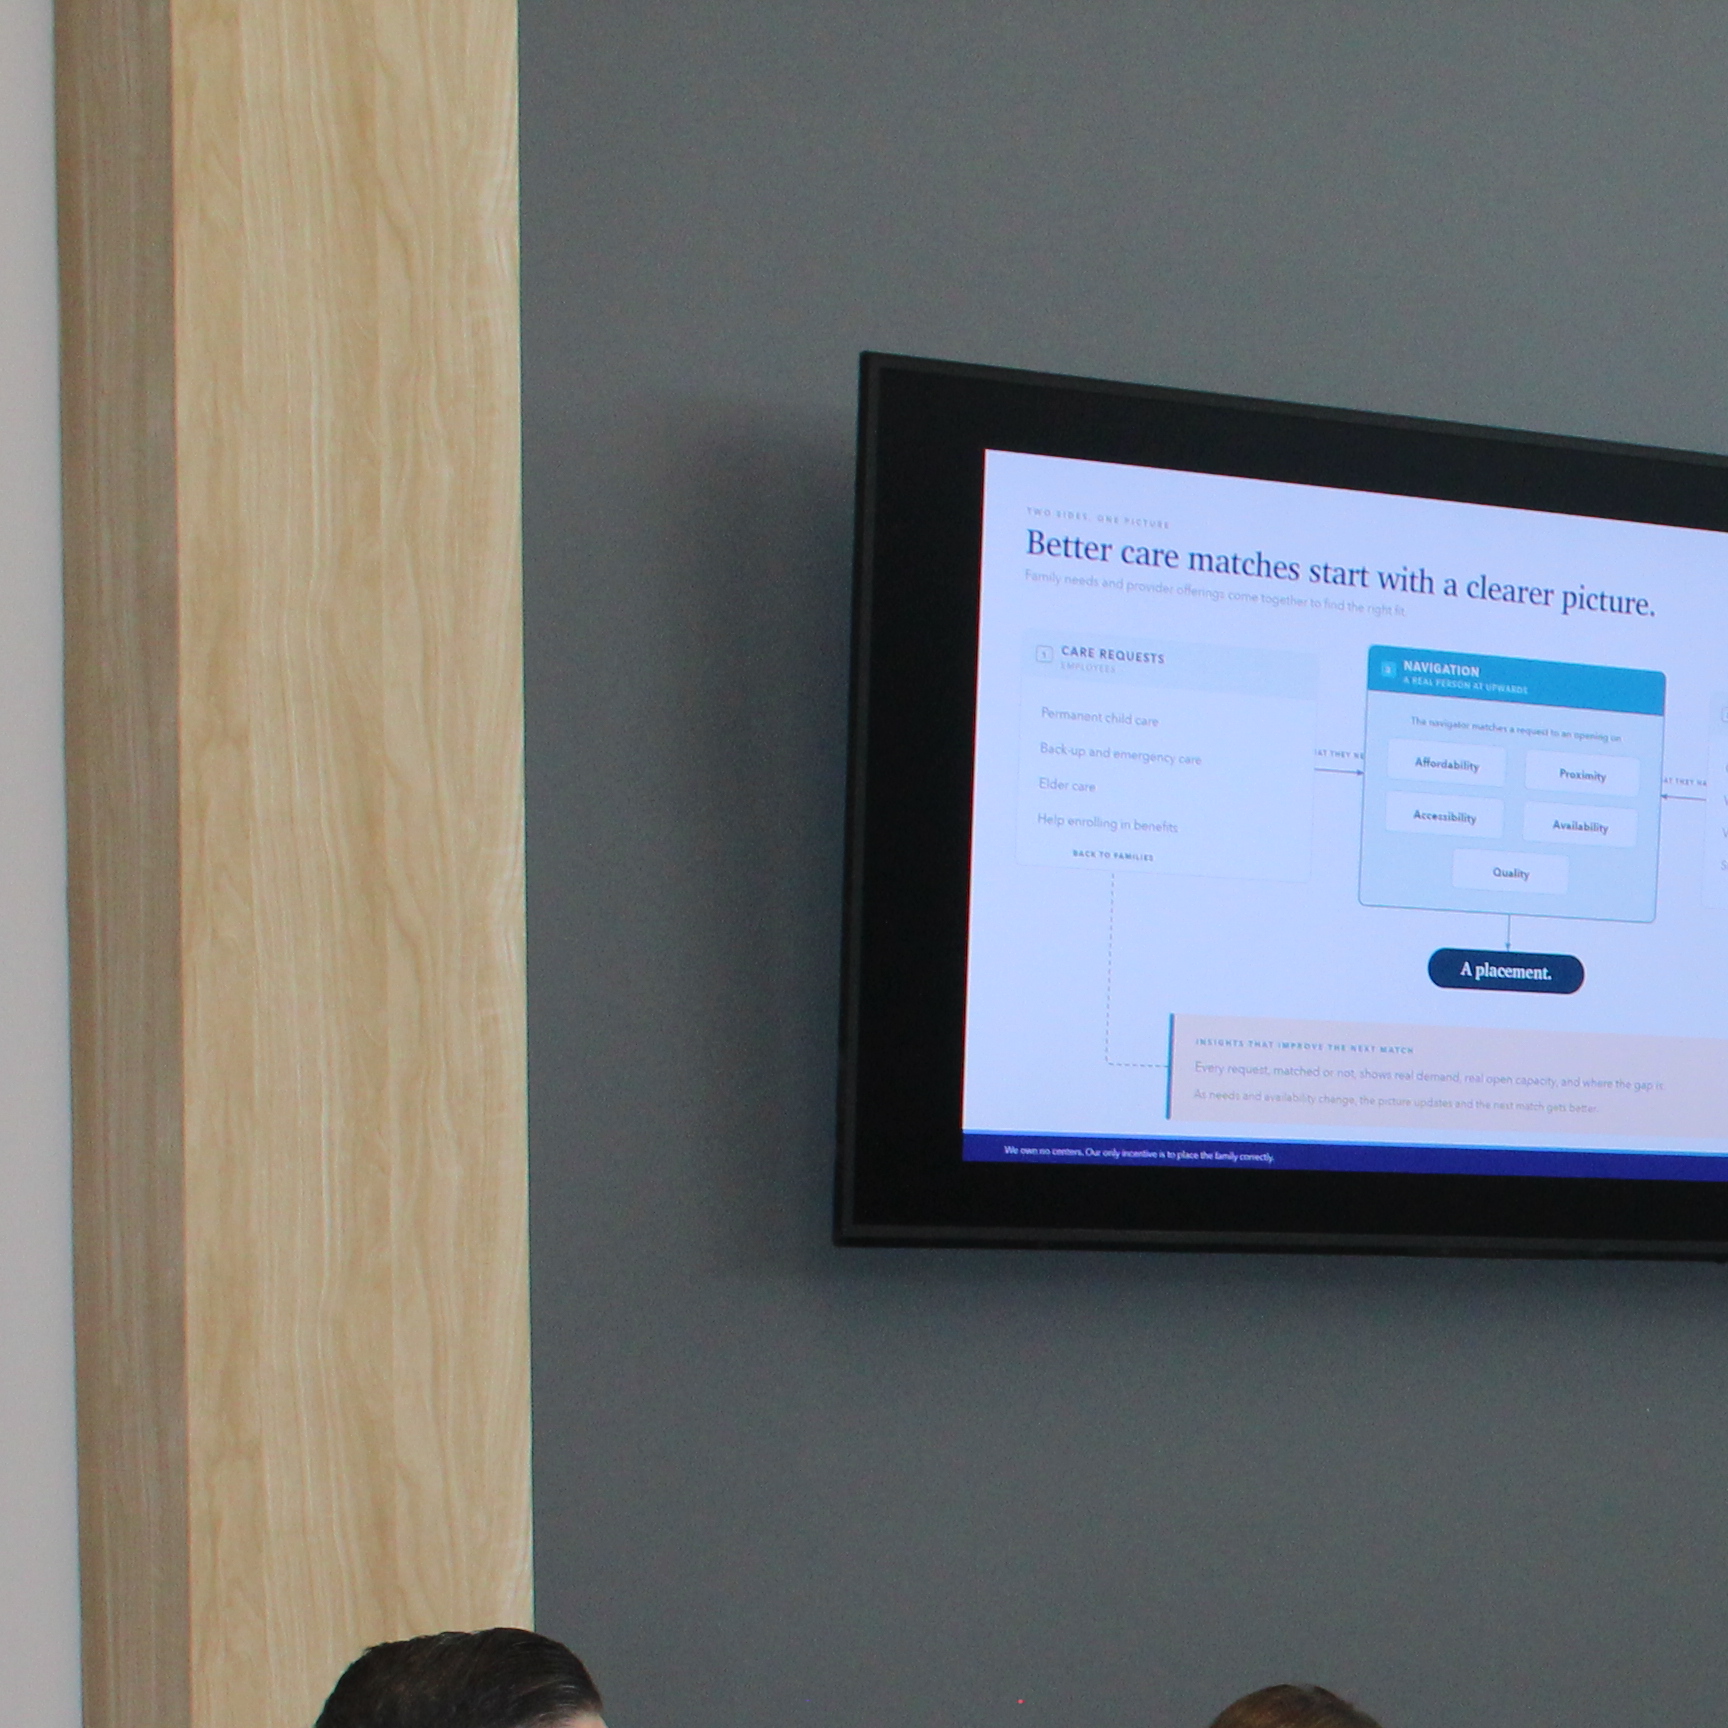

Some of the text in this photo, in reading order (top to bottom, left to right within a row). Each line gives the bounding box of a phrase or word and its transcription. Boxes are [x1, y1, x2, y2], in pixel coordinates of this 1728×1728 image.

[1027, 528, 1655, 615] Better care matches start with a clearer picture.
[1026, 569, 1061, 586] Family
[1065, 574, 1098, 587] needs
[1102, 577, 1123, 590] and
[1126, 578, 1173, 597] provider
[1177, 582, 1225, 602] offerings
[1228, 589, 1258, 603] come
[1261, 589, 1308, 609] together
[1310, 597, 1320, 608] to
[1325, 597, 1344, 611] find
[1347, 600, 1364, 613] the
[1367, 602, 1392, 618] right
[1060, 645, 1165, 665] CARE REQUESTS
[1403, 660, 1480, 678] NAVIGATION
[1041, 706, 1159, 727] Permanent child care
[1040, 742, 1202, 767] Back-up and emergency care
[1415, 756, 1480, 774] Affordability
[1039, 777, 1096, 793] Elder care
[1559, 768, 1607, 784] Proximity
[1037, 813, 1179, 834] Help enrolling in benefits
[1413, 809, 1477, 826] Accessibility
[1552, 819, 1609, 836] Availability
[1072, 849, 1154, 862] BACK TO FAMILIES
[1492, 867, 1530, 882] Quality
[1460, 961, 1552, 981] A placement.
[1195, 1038, 1244, 1048] INSIGHTS
[1248, 1040, 1274, 1049] THAT
[1195, 1061, 1225, 1076] Every
[1273, 1065, 1320, 1078] matched
[1323, 1070, 1334, 1078] or
[1359, 1069, 1391, 1080] shows
[1394, 1070, 1414, 1081] real
[1464, 1074, 1483, 1084] real
[1485, 1077, 1513, 1088] open
[1561, 1077, 1580, 1088] and
[1583, 1078, 1613, 1089] where
[1615, 1079, 1631, 1089] the
[1634, 1081, 1652, 1093] gap
